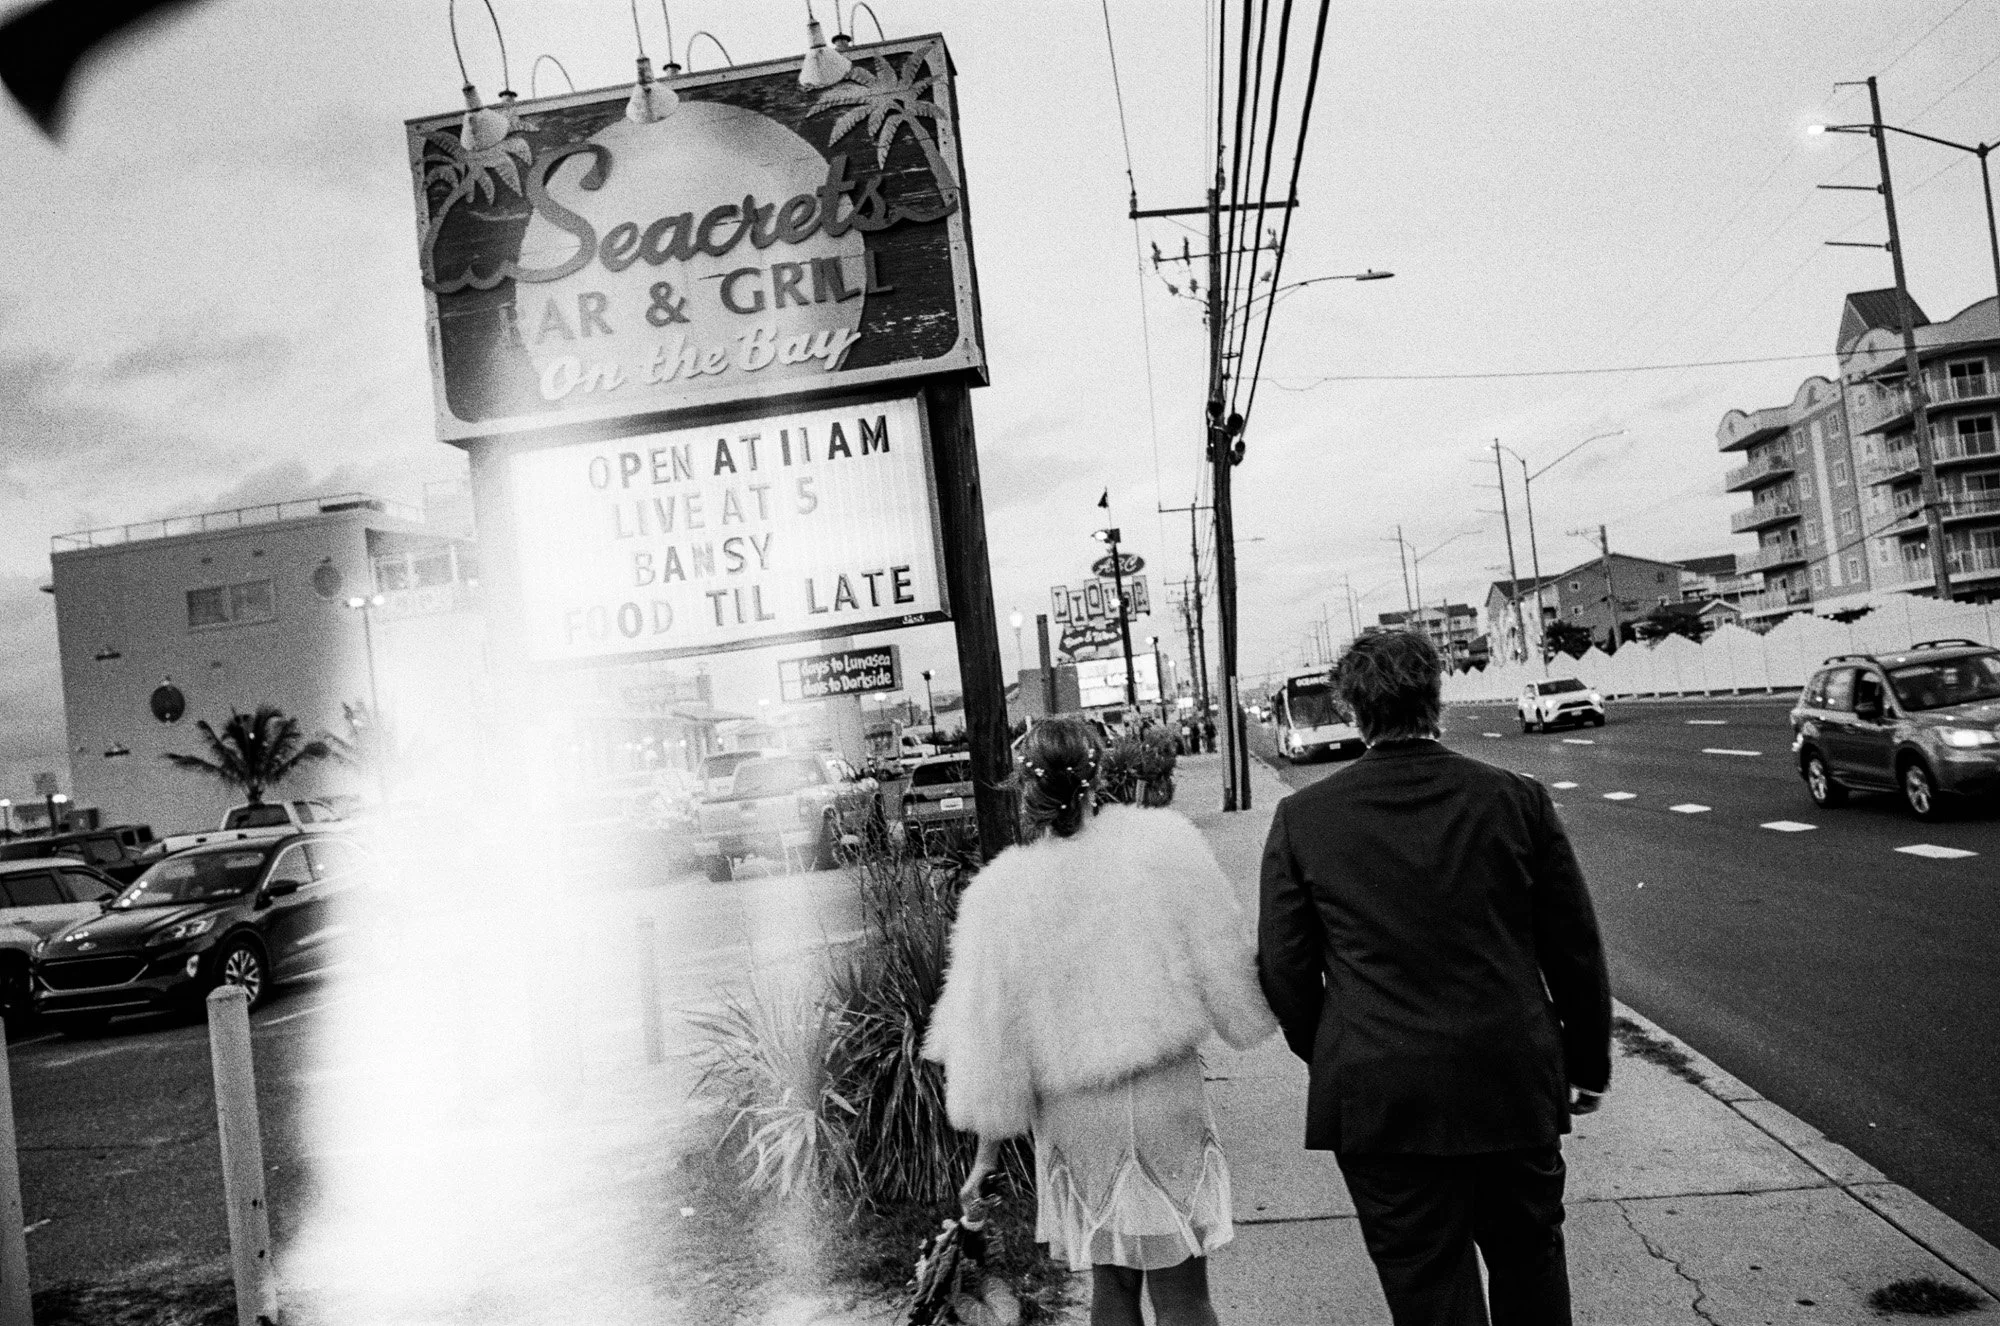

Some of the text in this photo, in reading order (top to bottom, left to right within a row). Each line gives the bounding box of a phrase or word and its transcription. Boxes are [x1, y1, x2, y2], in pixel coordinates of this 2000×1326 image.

[423, 142, 960, 293] Seacrets
[646, 281, 690, 328] &
[720, 248, 895, 315] GRILL
[540, 325, 862, 401] On the Bay
[588, 443, 694, 490] OPEN
[713, 434, 761, 476] AT
[612, 477, 819, 541] LIVE AT 5
[633, 532, 772, 587] BANSY
[563, 565, 915, 646] FOOD TIL LATE
[829, 675, 842, 692] to
[842, 668, 892, 691] Darkside
[830, 657, 843, 672] to
[844, 654, 891, 672] Lunasea
